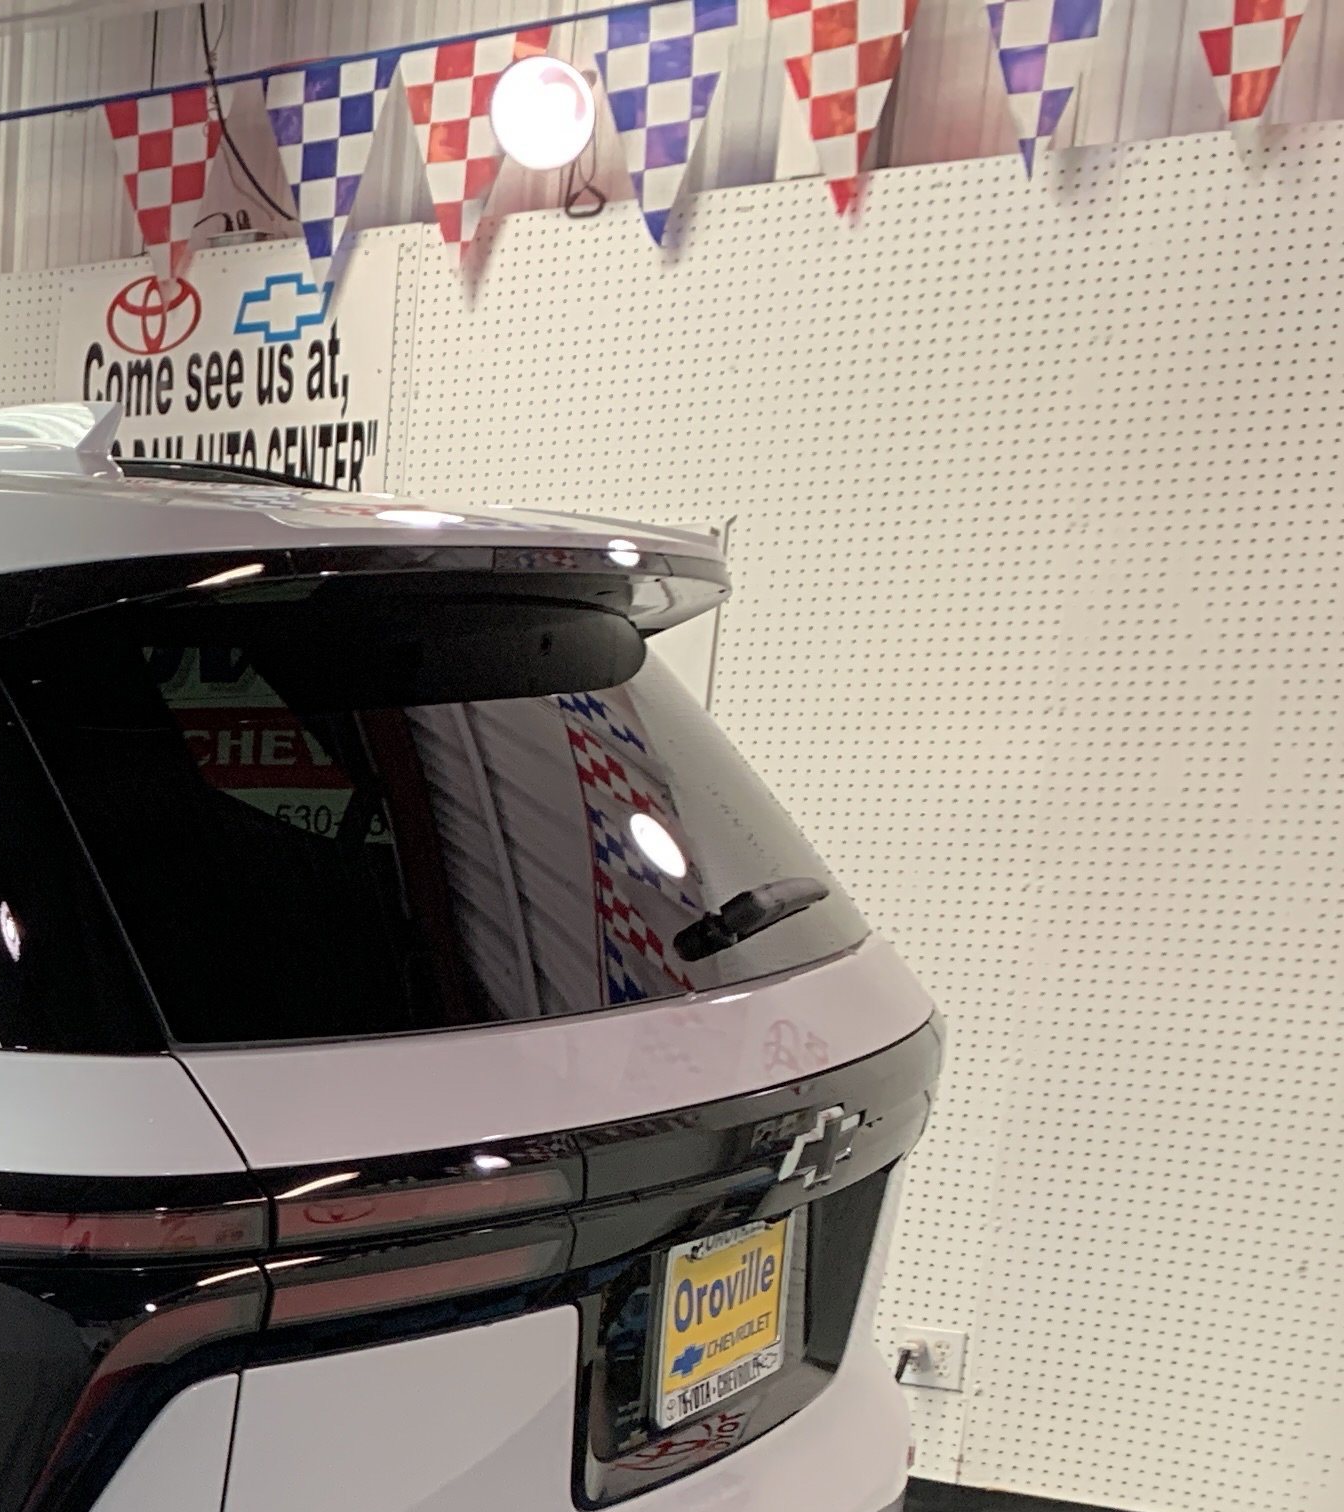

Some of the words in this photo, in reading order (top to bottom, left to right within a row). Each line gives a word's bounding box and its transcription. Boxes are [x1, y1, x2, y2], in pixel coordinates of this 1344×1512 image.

[83, 342, 173, 417] Come
[184, 348, 243, 412] see
[257, 343, 293, 404] us
[306, 317, 349, 417] at,
[674, 1248, 775, 1333] Oroville
[707, 1311, 771, 1359] CHEVROLET
